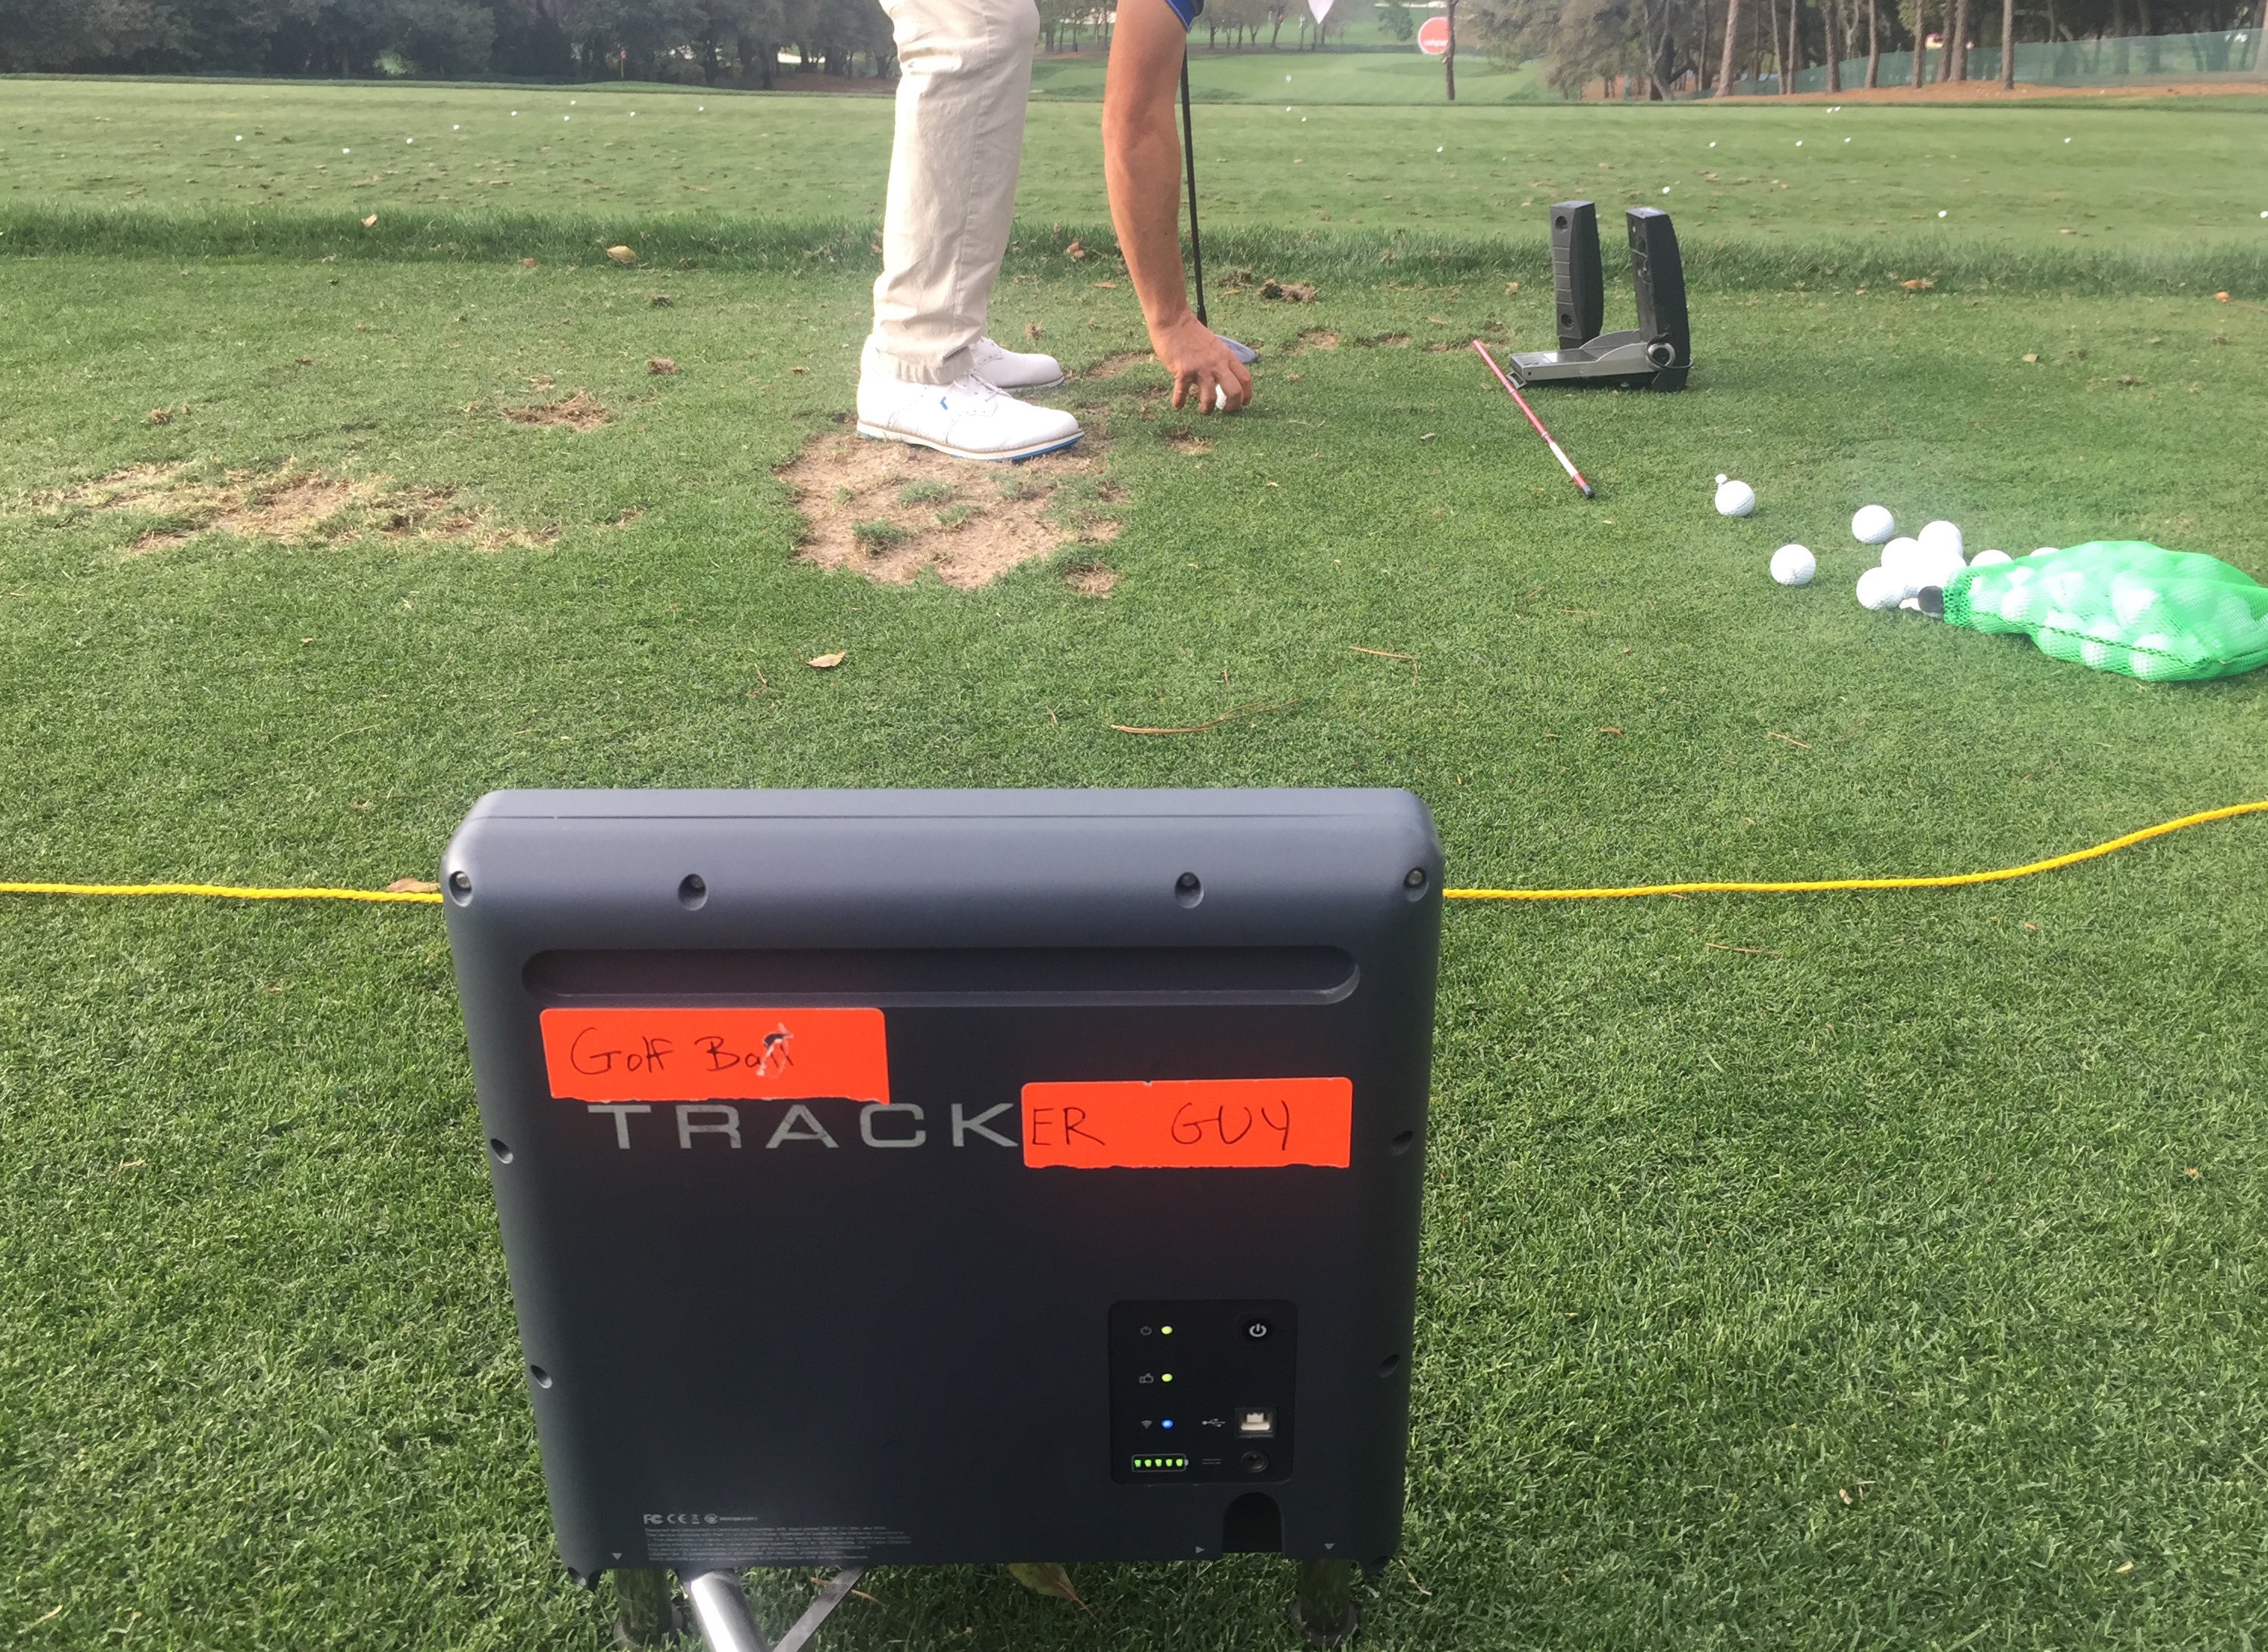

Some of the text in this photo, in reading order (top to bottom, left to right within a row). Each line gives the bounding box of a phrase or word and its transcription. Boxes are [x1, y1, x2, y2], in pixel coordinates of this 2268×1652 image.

[587, 1103, 1019, 1150] TRACK
[1032, 1100, 1291, 1150] ER GUY
